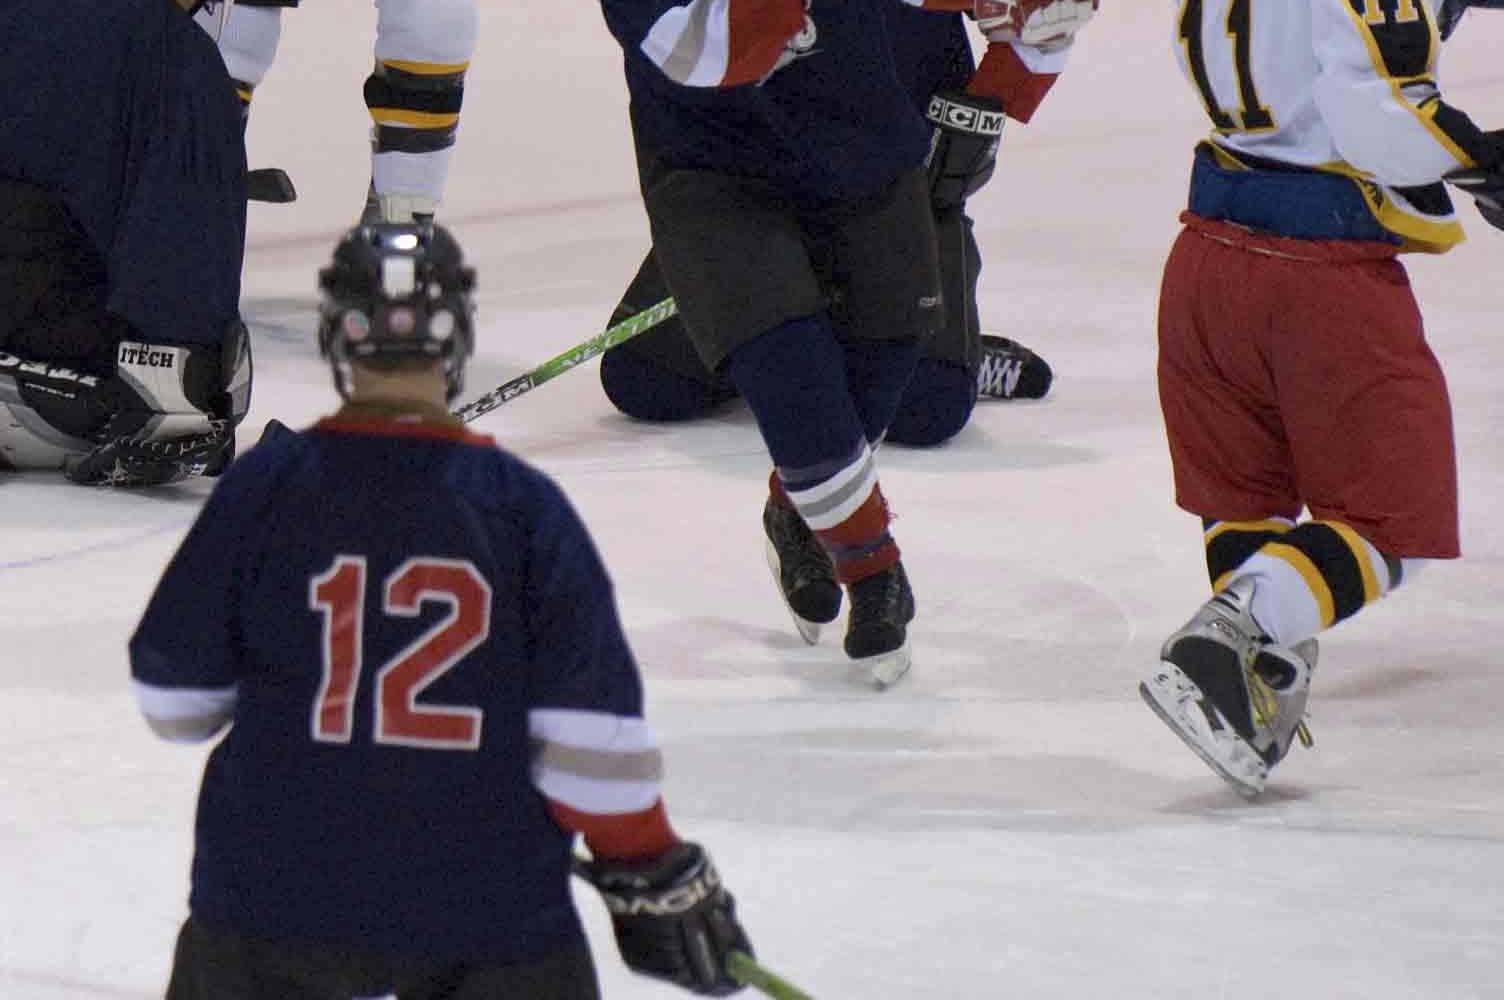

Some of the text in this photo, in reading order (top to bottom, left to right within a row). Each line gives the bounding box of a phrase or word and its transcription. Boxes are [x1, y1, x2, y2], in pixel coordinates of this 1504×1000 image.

[928, 97, 1006, 135] CCM
[119, 350, 176, 370] ITECH
[309, 555, 493, 750] 12
